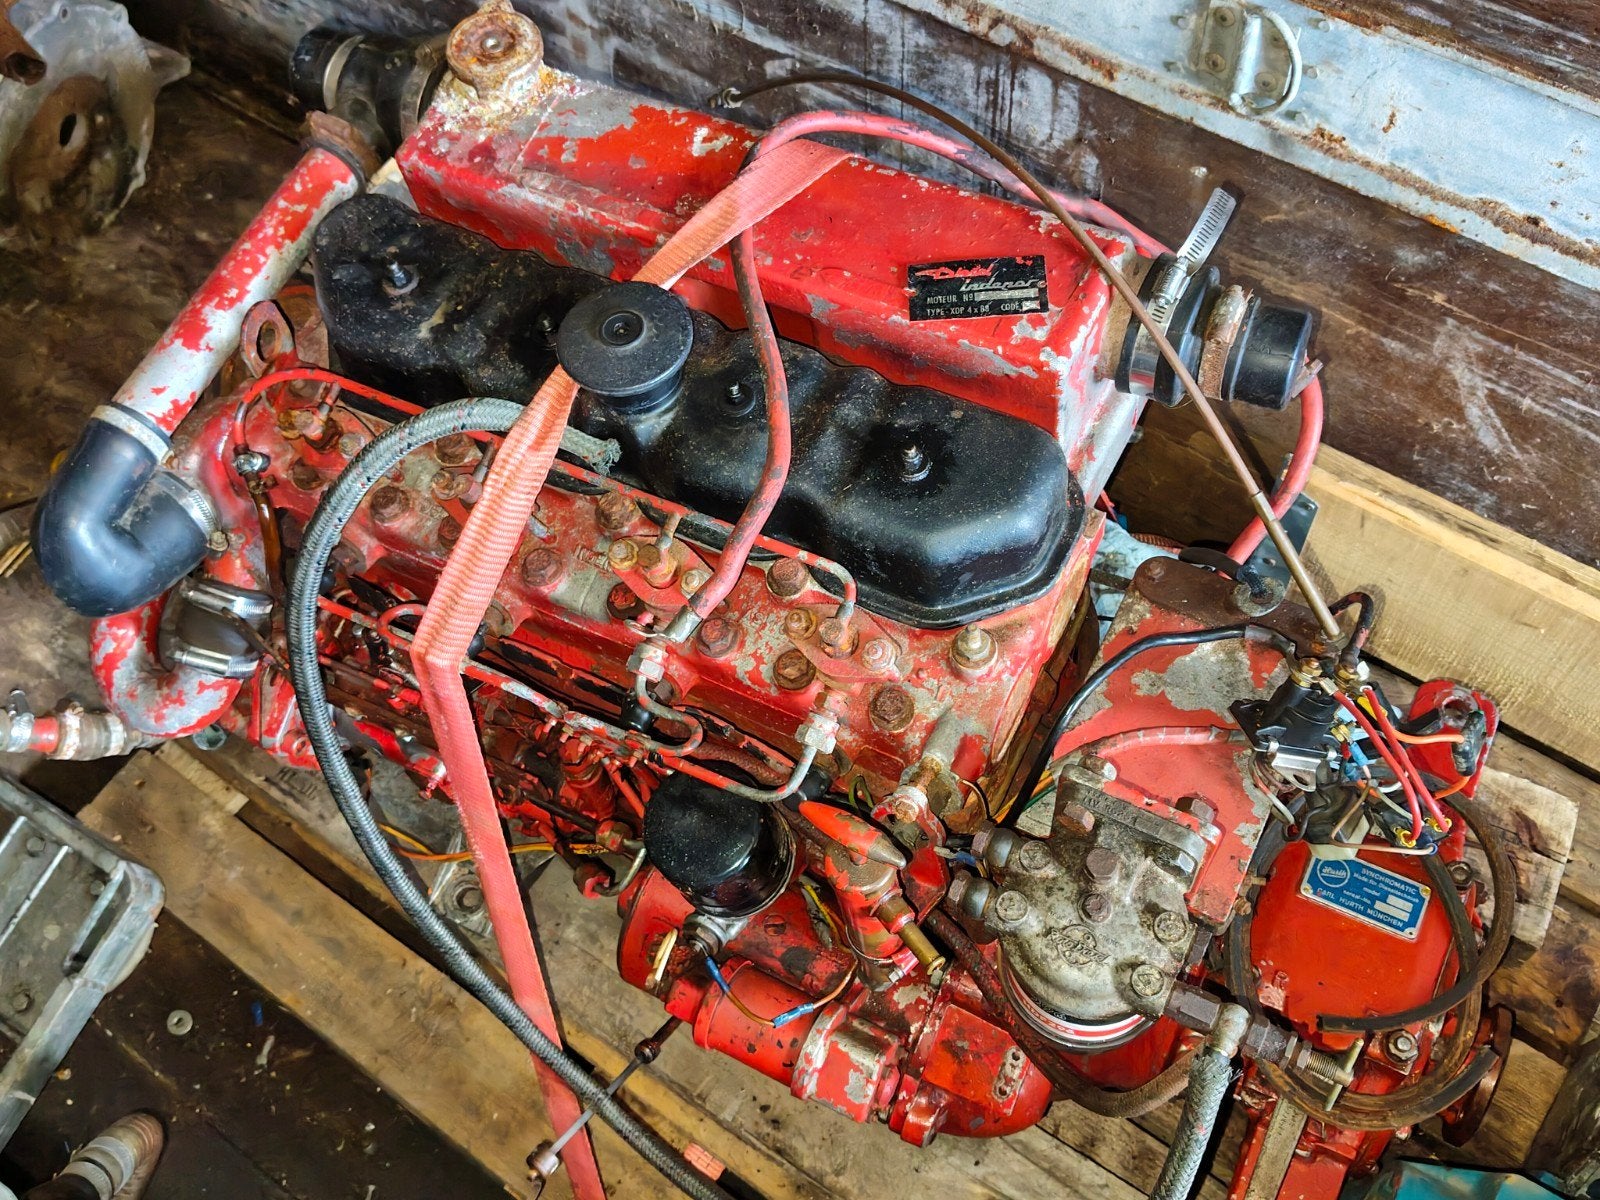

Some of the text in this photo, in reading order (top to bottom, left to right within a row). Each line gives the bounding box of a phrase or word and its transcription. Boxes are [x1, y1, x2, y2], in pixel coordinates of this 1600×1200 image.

[959, 271, 1040, 291] indenor
[926, 294, 958, 305] MOTEUR
[1360, 867, 1418, 895] SYNCHROMATIC
[1317, 887, 1404, 928] CARL HURTH MÜNCHEN
